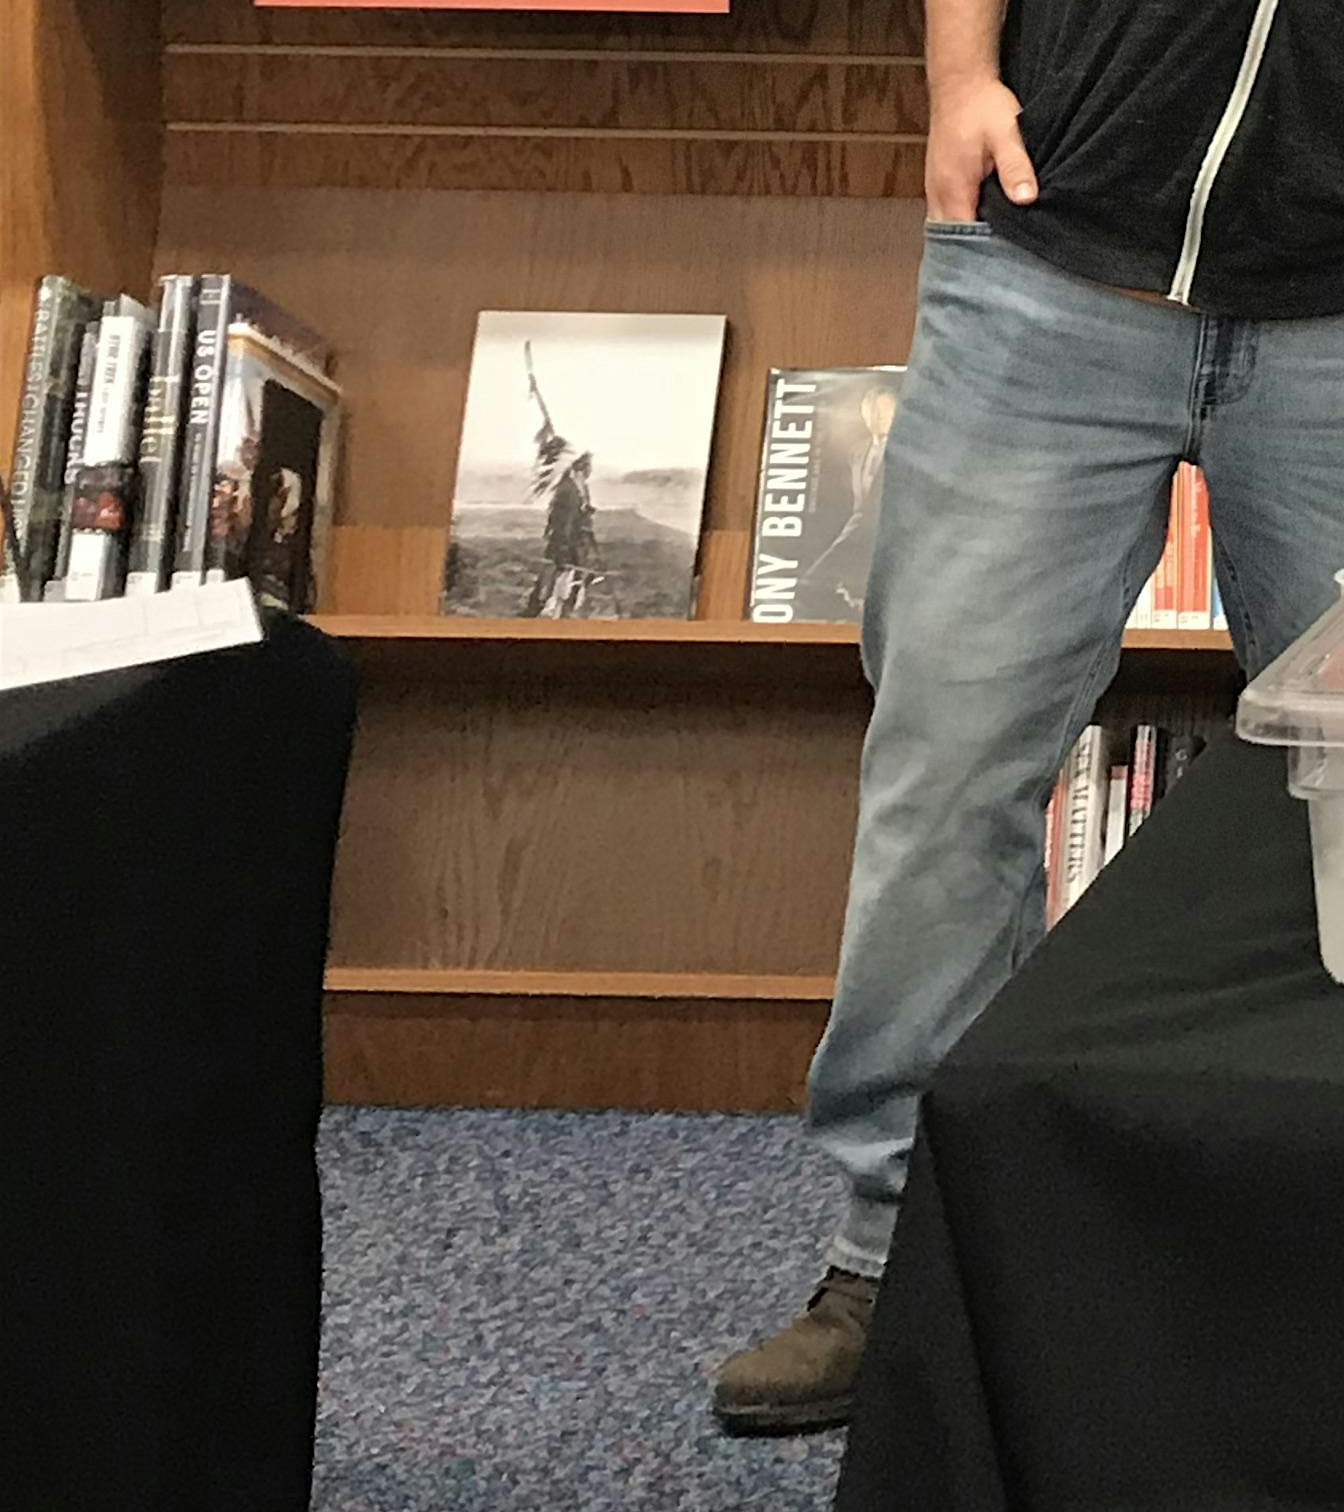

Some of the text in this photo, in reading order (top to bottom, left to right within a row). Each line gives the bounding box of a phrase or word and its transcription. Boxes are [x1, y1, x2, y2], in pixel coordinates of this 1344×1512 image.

[190, 329, 217, 425] US OPEN
[752, 378, 817, 624] ONY BENNETT
